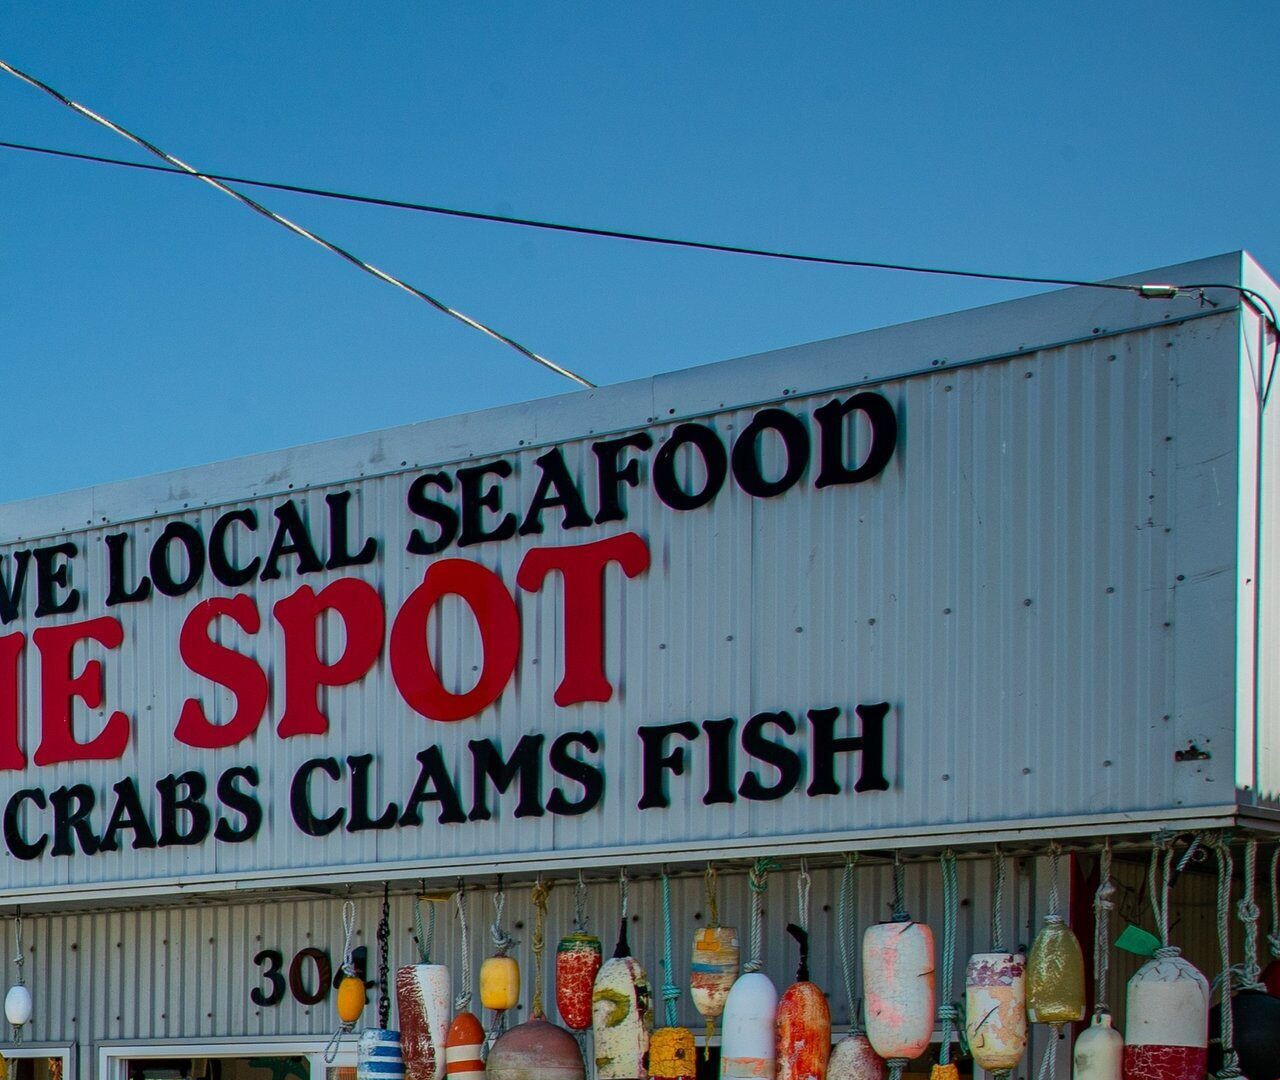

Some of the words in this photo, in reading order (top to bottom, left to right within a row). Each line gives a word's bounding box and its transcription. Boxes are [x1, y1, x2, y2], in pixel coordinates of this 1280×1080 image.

[105, 491, 378, 606] LOCAL
[406, 391, 898, 556] SEAFOOD
[174, 532, 651, 749] SPOT
[3, 766, 262, 860] CRABS
[290, 732, 606, 837] CLAMS
[637, 701, 890, 811] FISH
